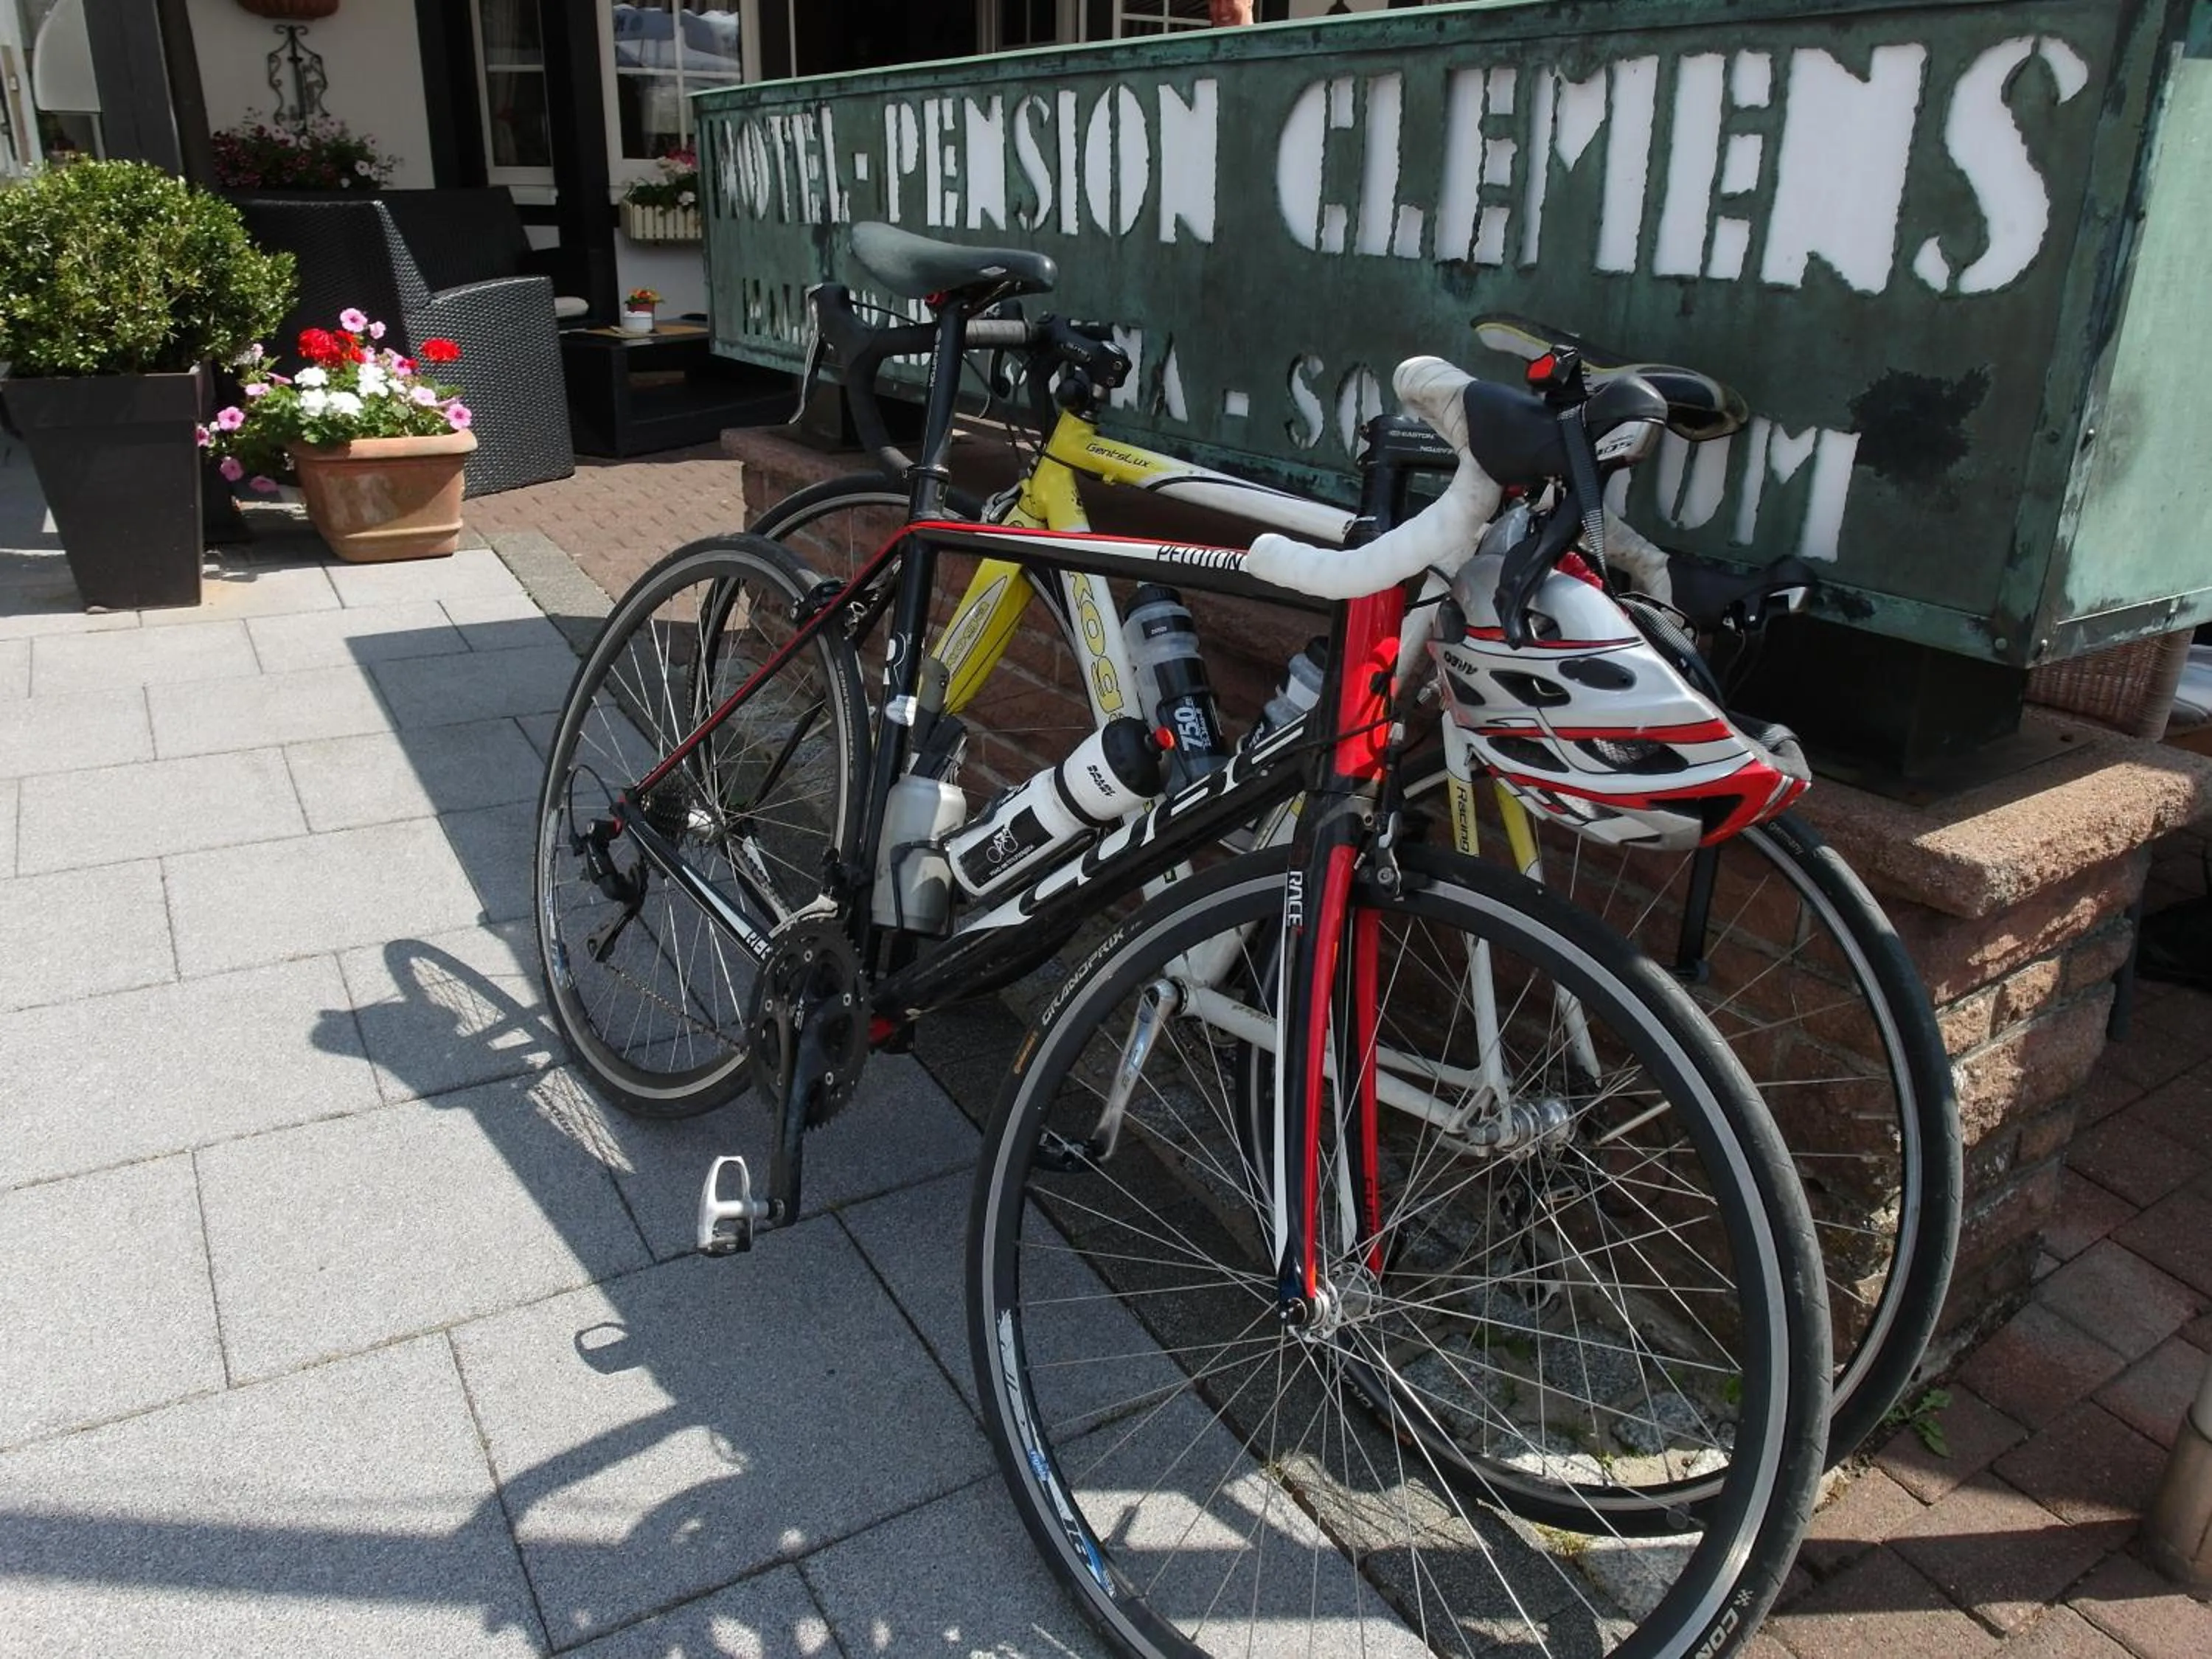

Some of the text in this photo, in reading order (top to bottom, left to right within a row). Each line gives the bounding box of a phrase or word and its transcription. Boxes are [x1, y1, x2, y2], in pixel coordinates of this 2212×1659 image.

[1276, 35, 2090, 295] CLEMENS
[1400, 430, 1439, 442] EASTON
[1455, 784, 1471, 855] Racing
[1287, 870, 1304, 928] RACE
